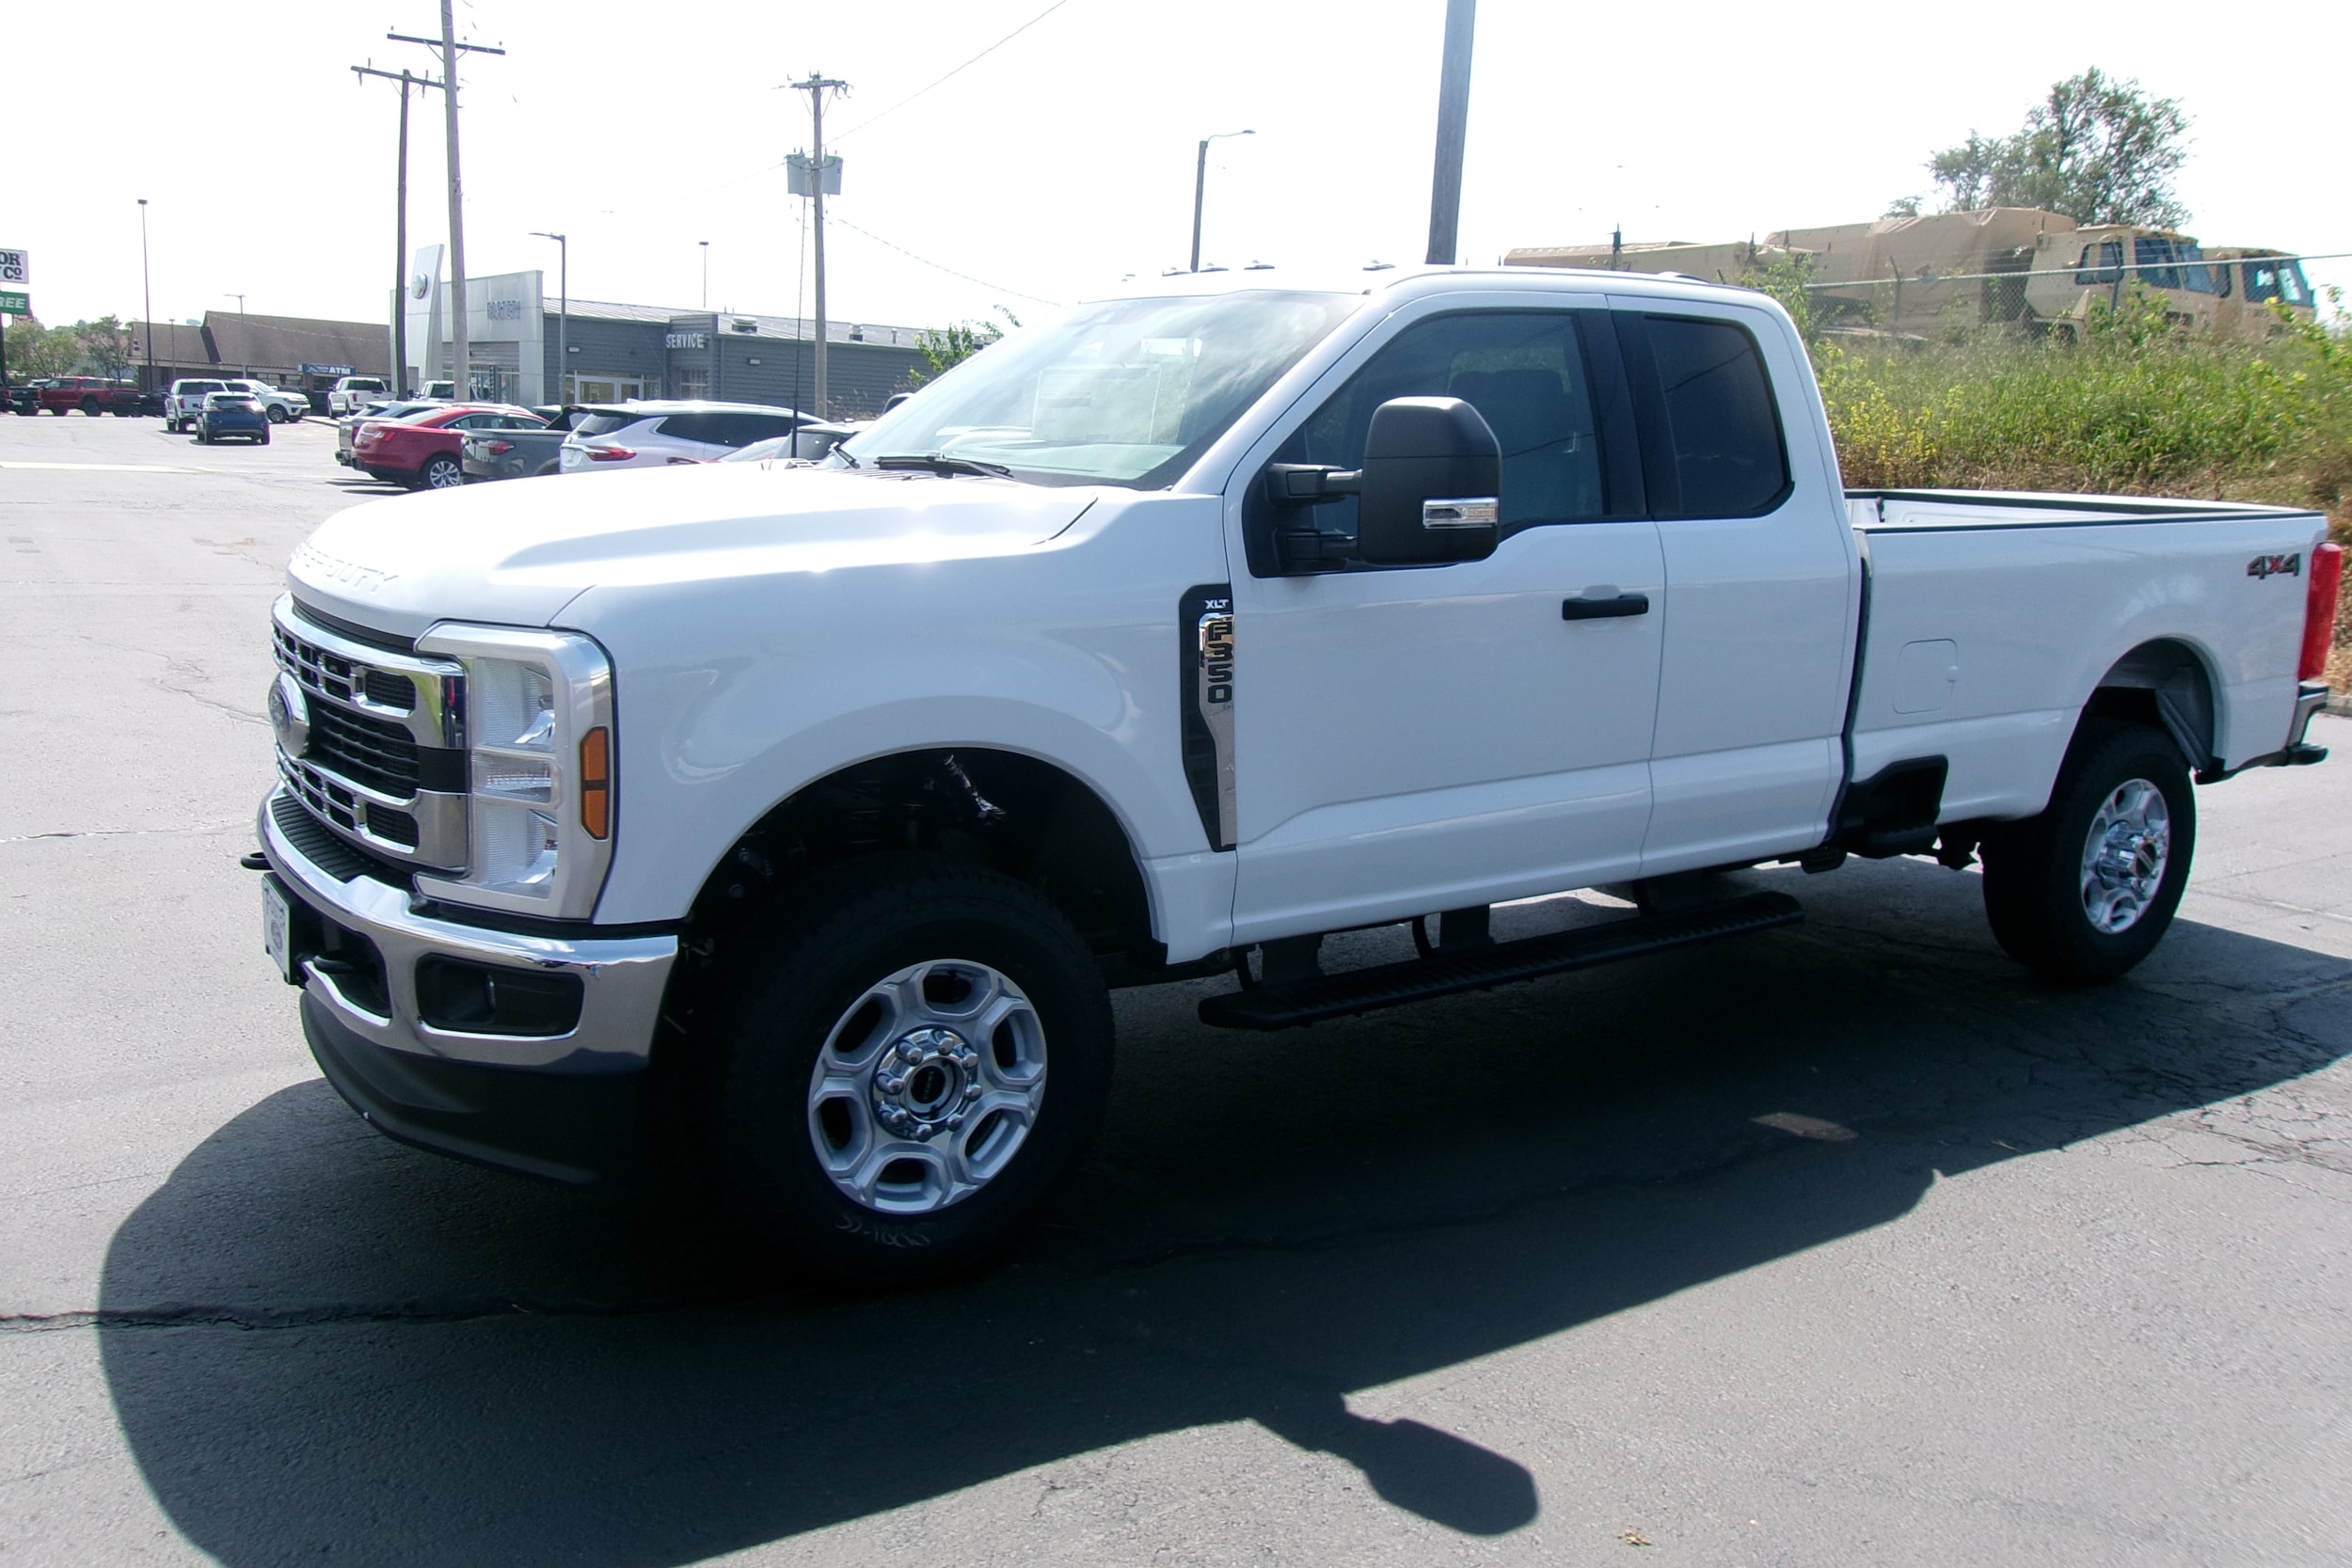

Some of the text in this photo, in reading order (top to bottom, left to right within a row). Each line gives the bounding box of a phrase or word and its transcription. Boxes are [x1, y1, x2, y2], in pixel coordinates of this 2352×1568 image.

[665, 333, 705, 349] SERVICE
[328, 367, 351, 375] ATM
[1205, 599, 1230, 609] XLT
